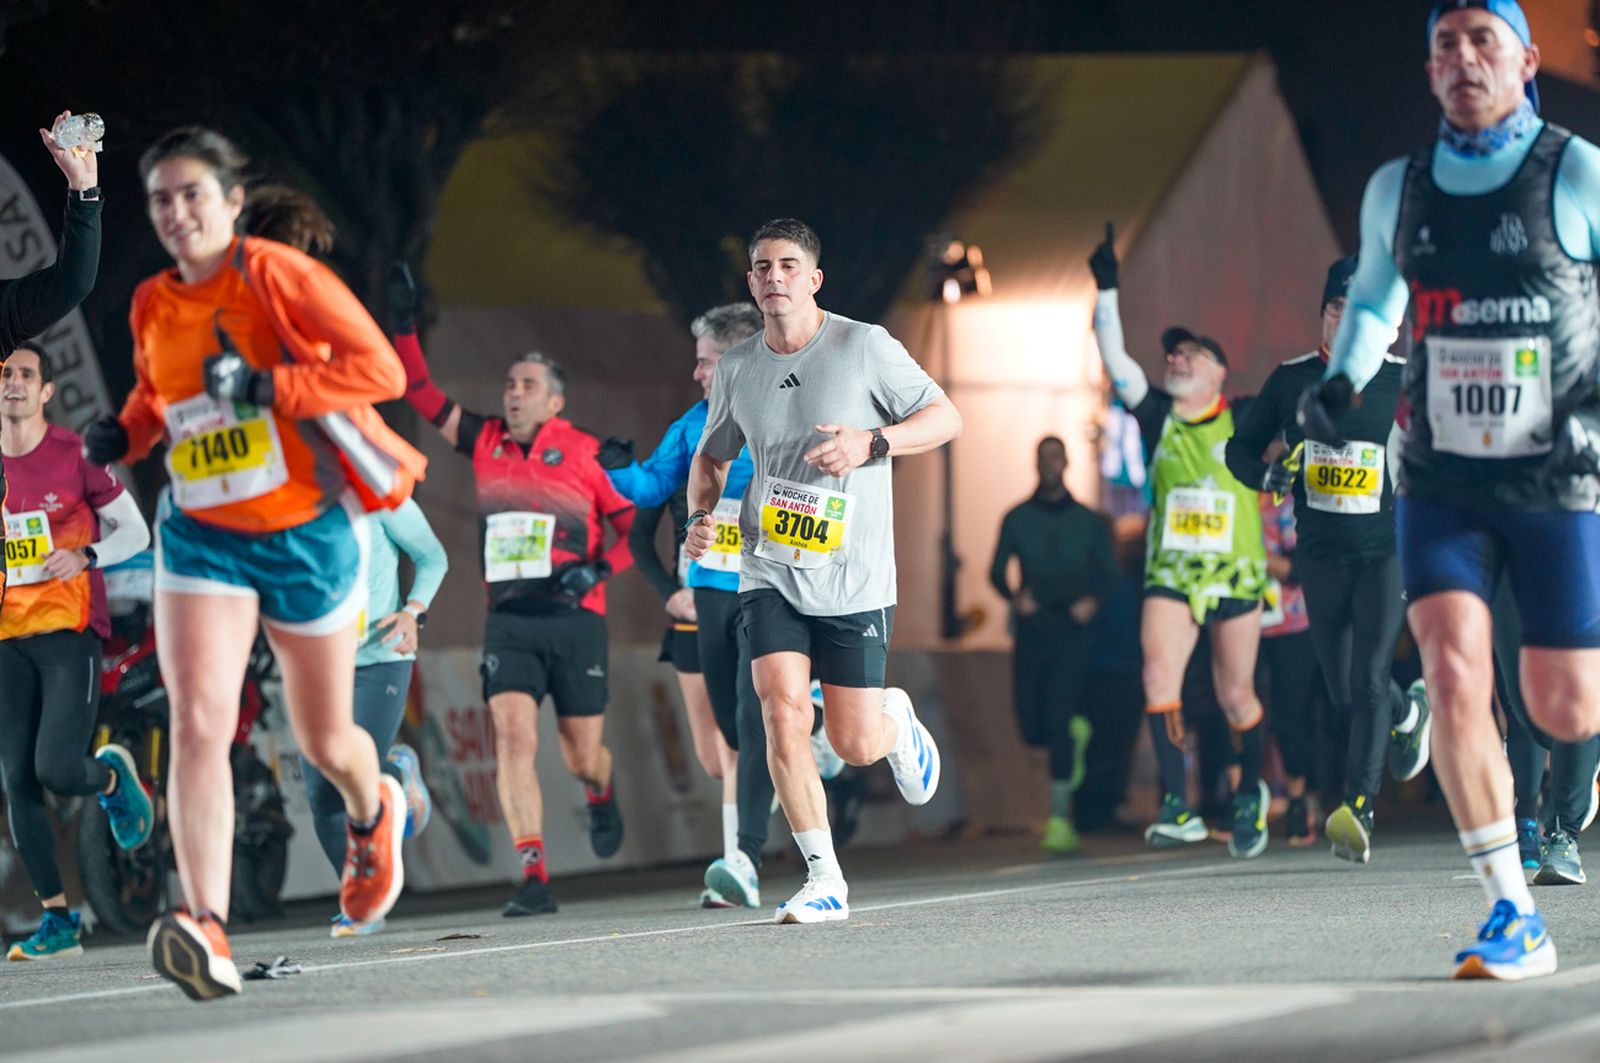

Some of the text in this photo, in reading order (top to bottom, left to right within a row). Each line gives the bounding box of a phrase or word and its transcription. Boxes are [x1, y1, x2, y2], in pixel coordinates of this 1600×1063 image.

[1451, 383, 1522, 415] 1007
[1317, 465, 1367, 489] 9622
[770, 497, 788, 509] SAN
[788, 500, 817, 515] ANTÓN
[781, 489, 808, 502] NOCHE
[808, 495, 820, 505] DE
[774, 509, 830, 545] 3704
